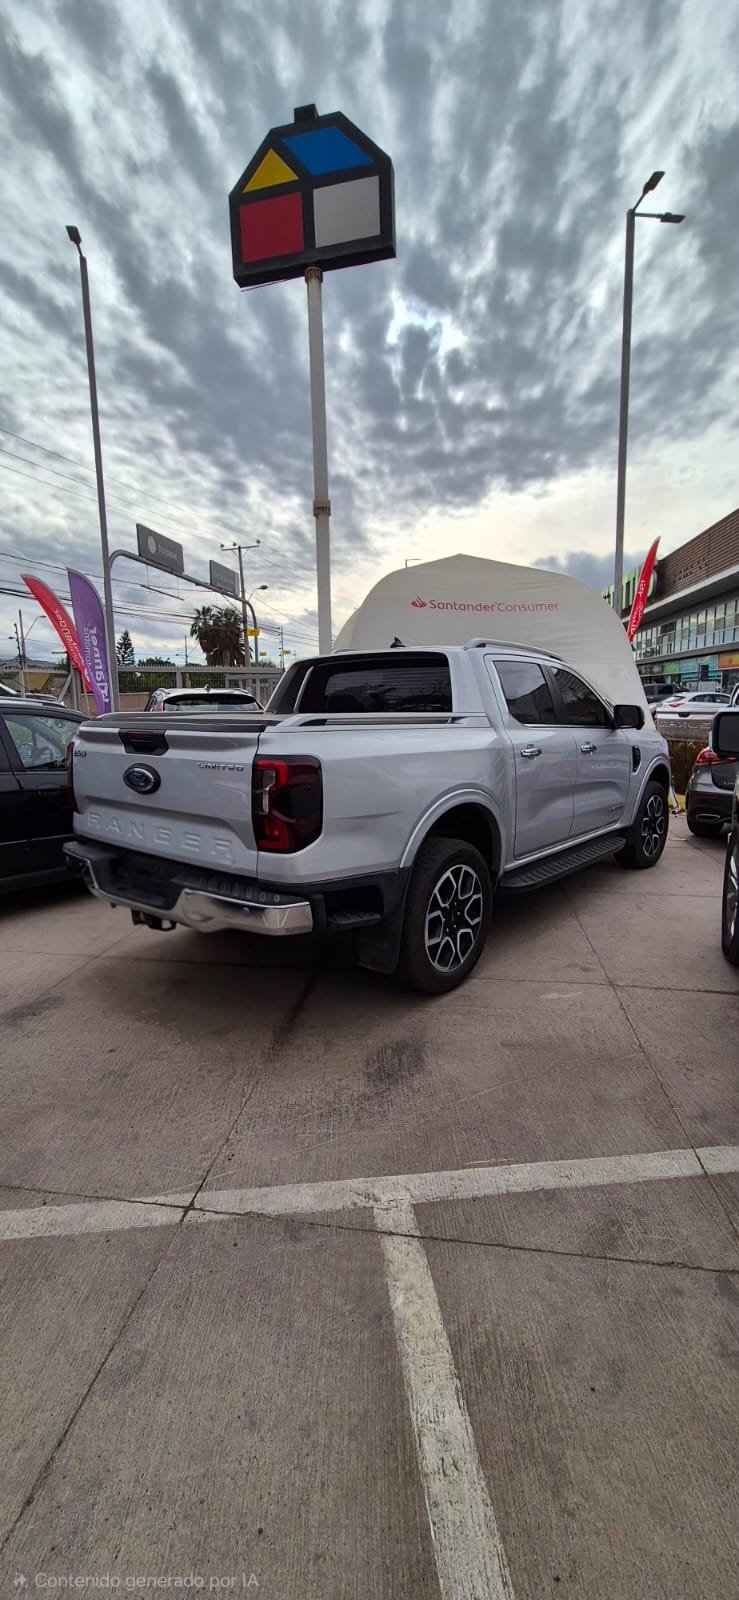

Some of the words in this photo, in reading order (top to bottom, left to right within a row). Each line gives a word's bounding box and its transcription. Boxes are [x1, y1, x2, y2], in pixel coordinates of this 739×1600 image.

[429, 599, 495, 613] Santander
[497, 601, 560, 613] Consumer
[87, 811, 237, 866] RANGER
